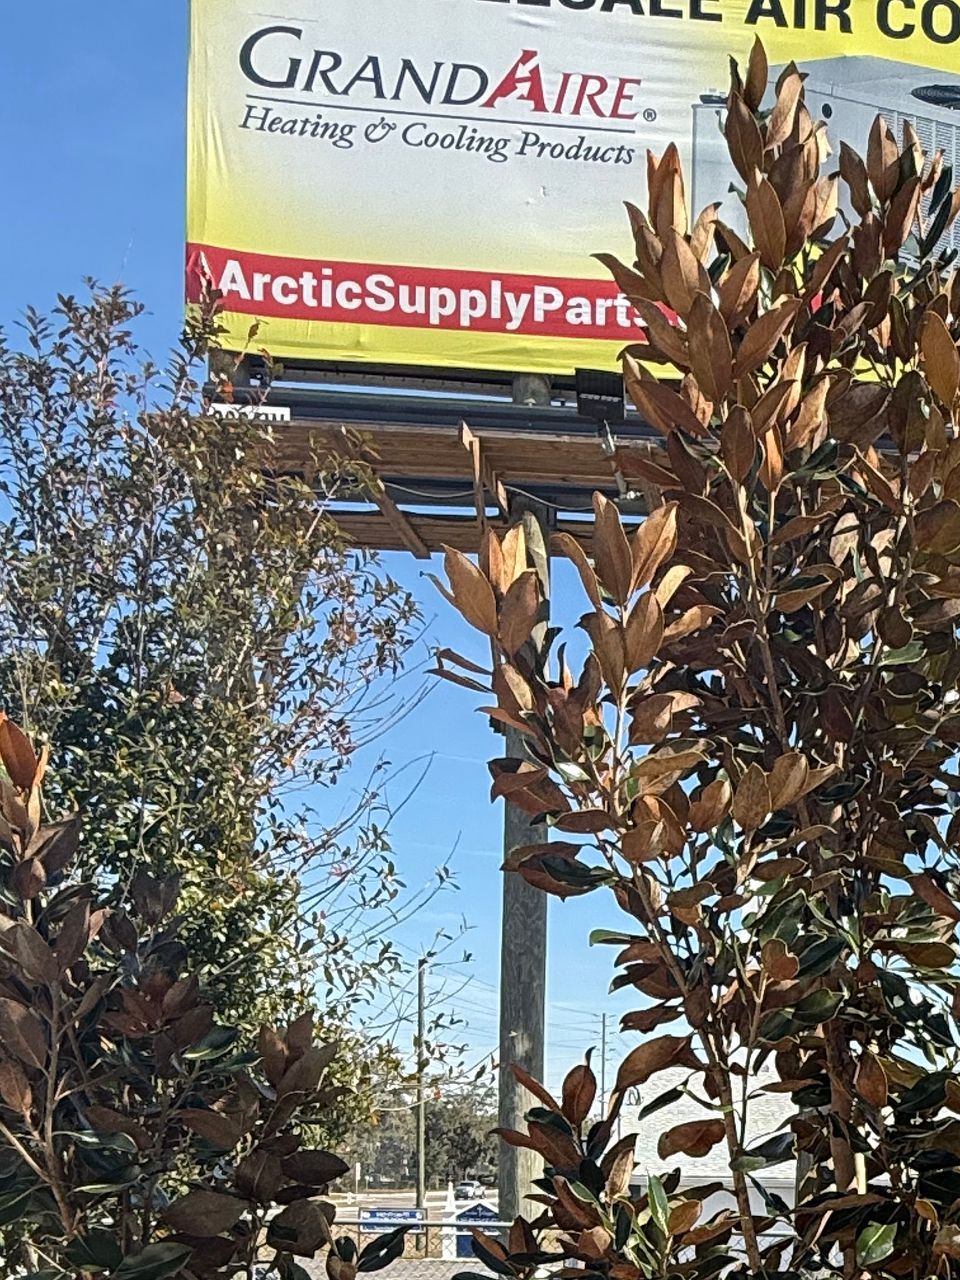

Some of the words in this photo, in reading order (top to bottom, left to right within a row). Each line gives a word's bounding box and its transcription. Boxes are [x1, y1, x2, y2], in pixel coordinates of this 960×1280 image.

[744, 0, 853, 34] AIR
[239, 104, 356, 149] Heating
[364, 117, 397, 143] &
[401, 122, 511, 163] Cooling
[514, 130, 635, 165] Products
